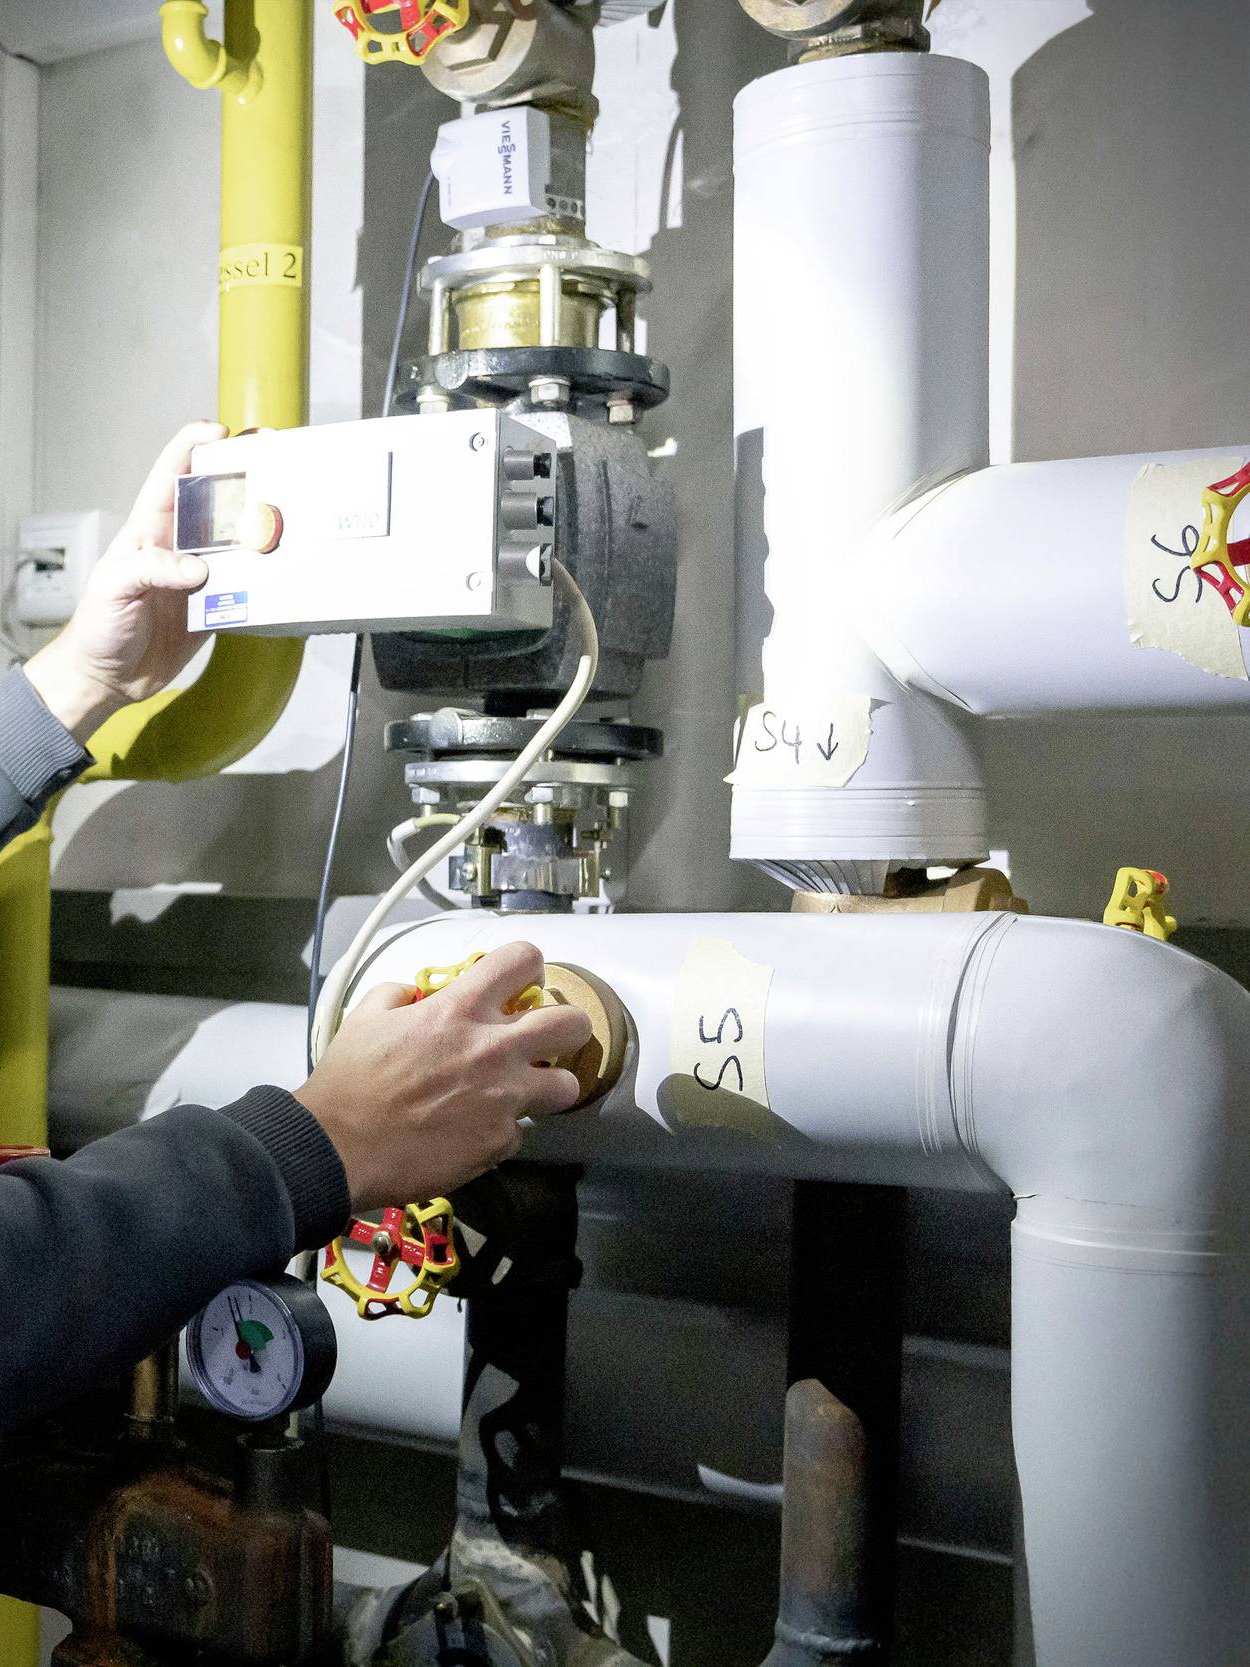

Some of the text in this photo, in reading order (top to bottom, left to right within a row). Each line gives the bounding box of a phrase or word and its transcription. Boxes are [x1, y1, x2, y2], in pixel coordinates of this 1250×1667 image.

[497, 119, 516, 195] VIESSMANN
[283, 252, 297, 279] 2
[1151, 524, 1203, 604] S6
[754, 710, 803, 765] S4
[693, 1007, 744, 1092] S5
